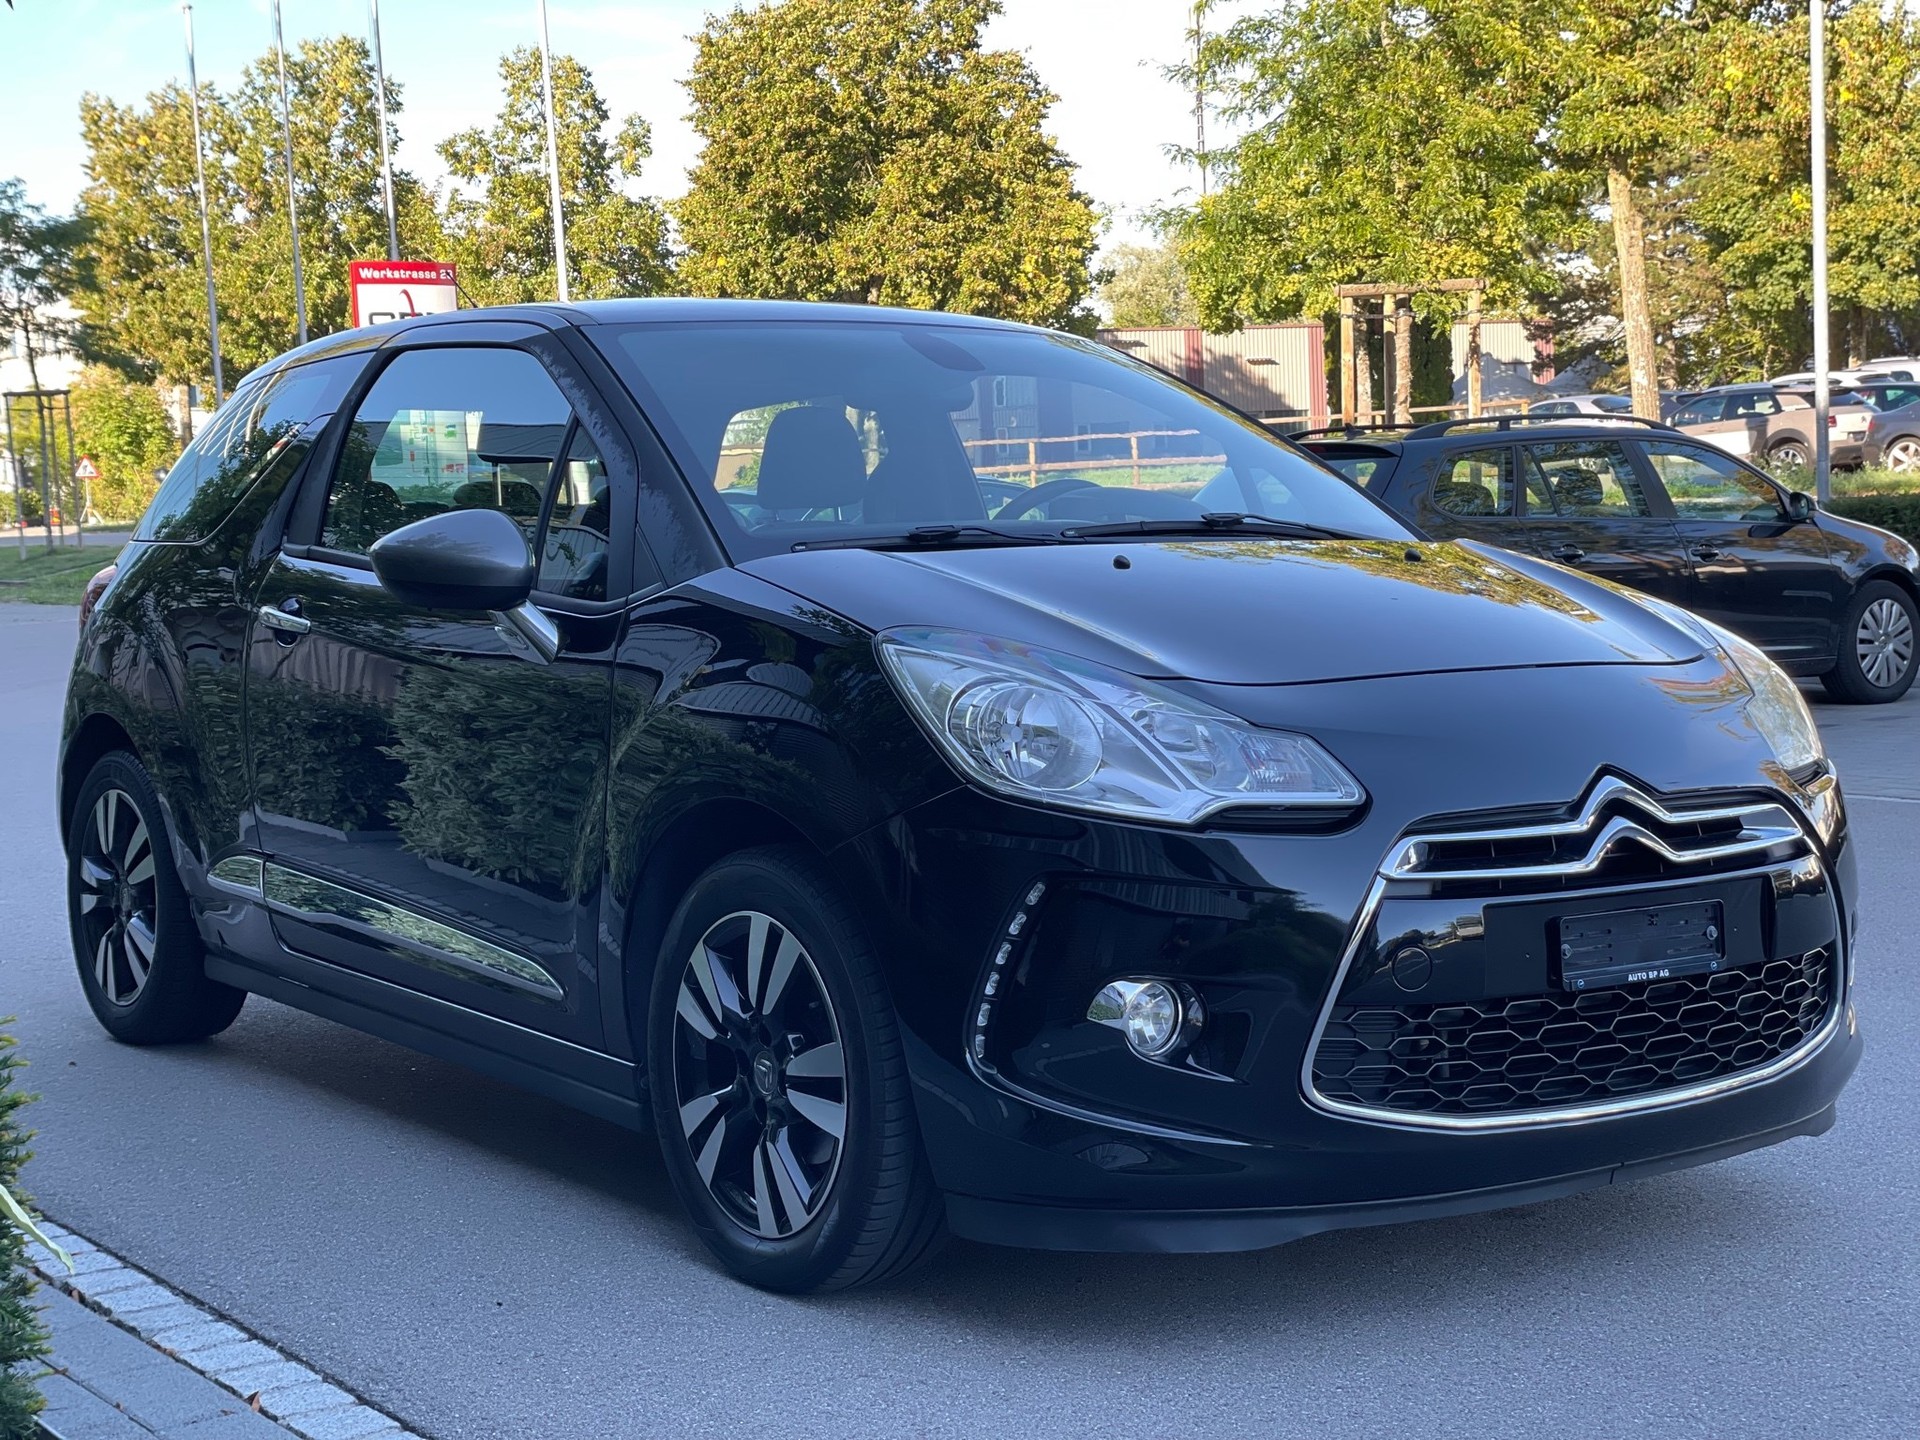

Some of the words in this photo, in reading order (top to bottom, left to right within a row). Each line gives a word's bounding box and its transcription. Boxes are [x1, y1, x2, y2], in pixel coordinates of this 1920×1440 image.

[358, 267, 436, 279] Werkstrasse
[1628, 972, 1647, 982] AUTO
[1648, 971, 1658, 979] BP
[1659, 969, 1670, 977] AG
